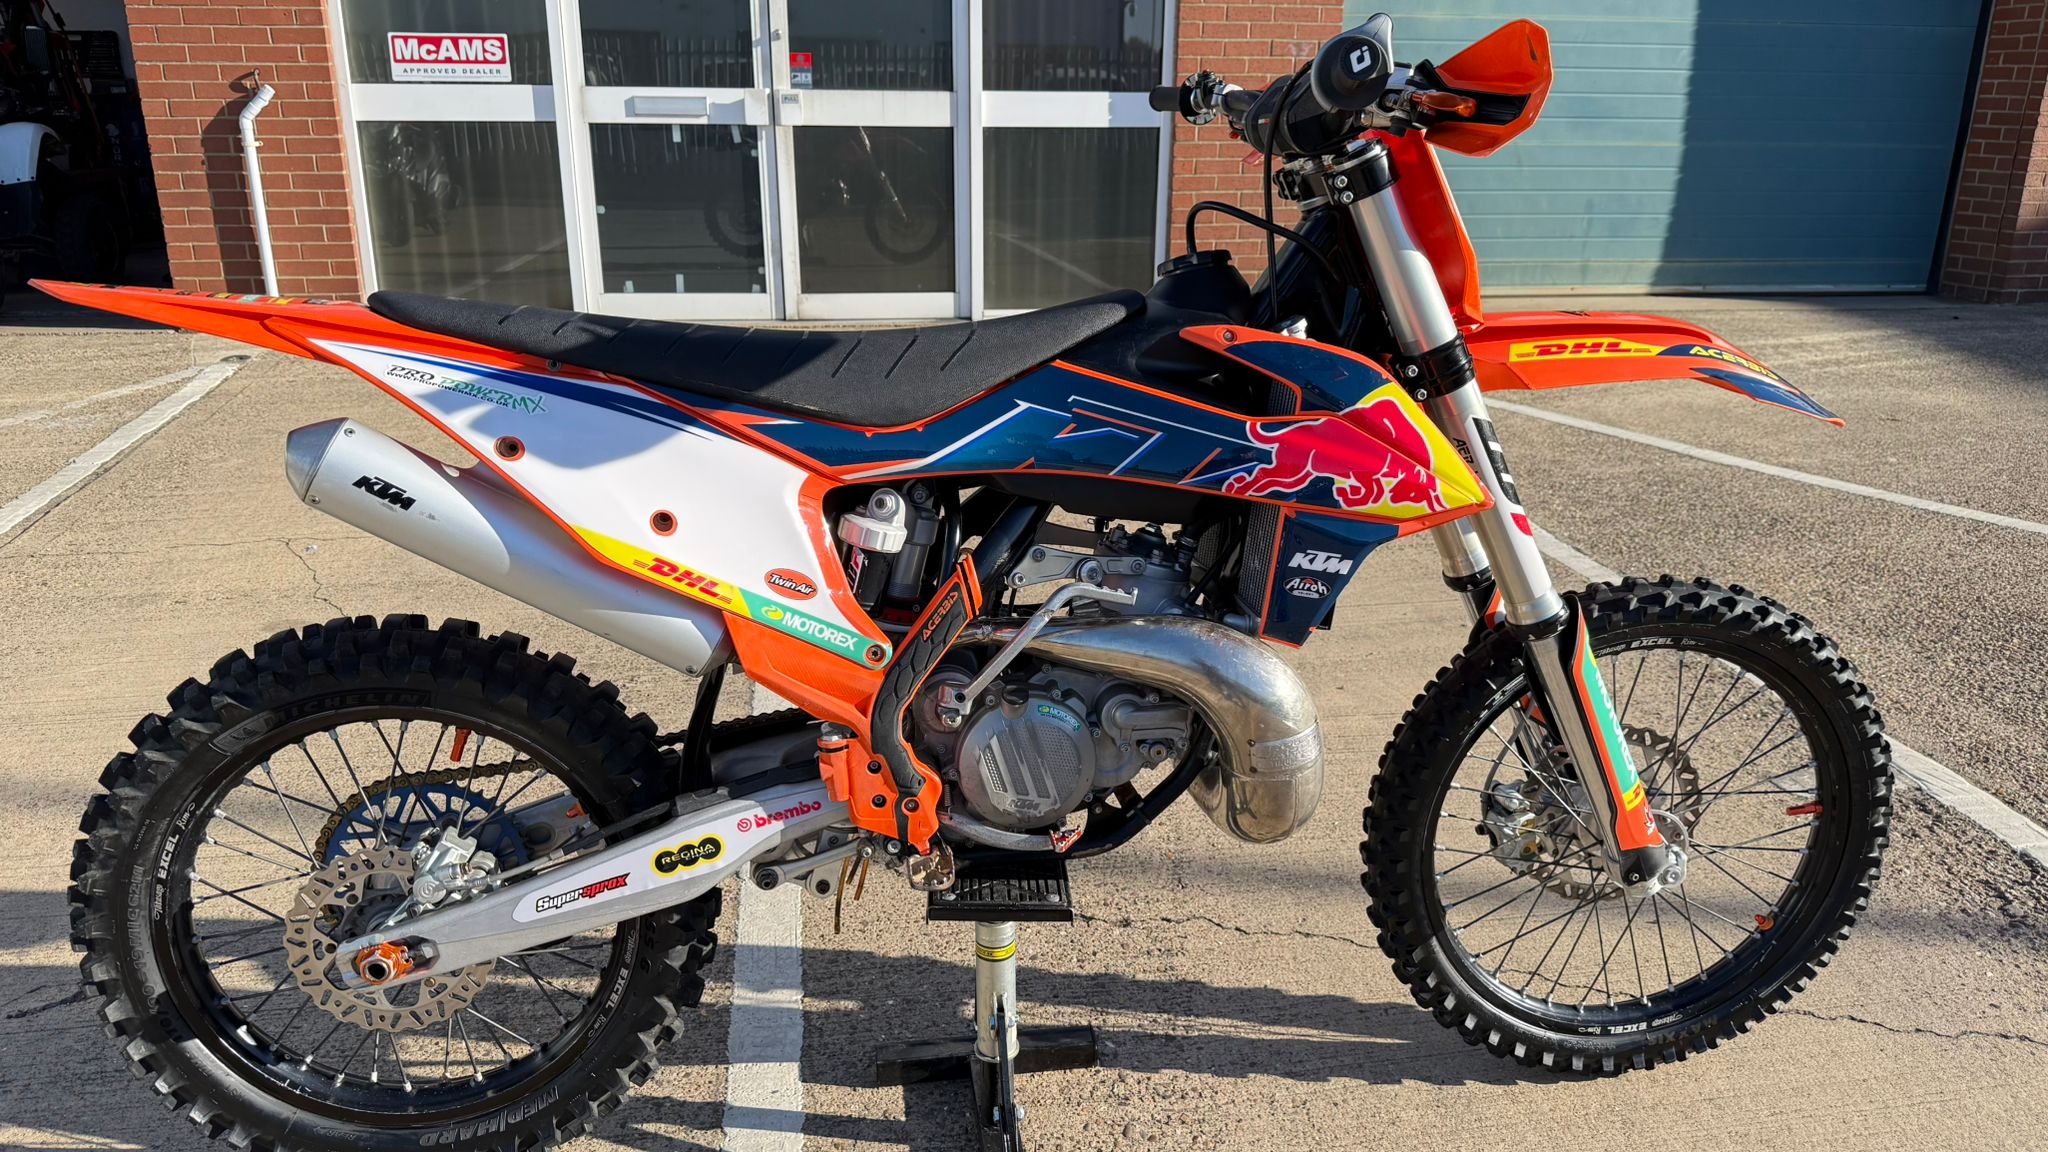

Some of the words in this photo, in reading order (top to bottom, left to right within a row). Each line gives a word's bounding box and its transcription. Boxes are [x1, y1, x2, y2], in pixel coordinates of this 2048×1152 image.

[393, 37, 503, 61] McAMS
[403, 67, 457, 75] APPROVED
[1531, 341, 1634, 357] DHL
[388, 364, 435, 381] PRO
[1689, 345, 1781, 381] ACERBIS
[352, 475, 416, 511] KTM
[1288, 549, 1353, 575] KTM
[646, 557, 722, 599] DHL
[768, 573, 797, 590] Twin
[795, 581, 814, 595] Air
[1286, 578, 1328, 595] Airoh
[782, 611, 858, 651] MOTOREX
[1630, 636, 1674, 649] EXCEL
[755, 800, 822, 828] brembo
[158, 834, 179, 880] EXCEL
[661, 842, 716, 865] REGINA
[536, 872, 631, 912] Supersprox
[606, 967, 628, 1009] EXCEL
[1608, 1022, 1647, 1034] EXCEL
